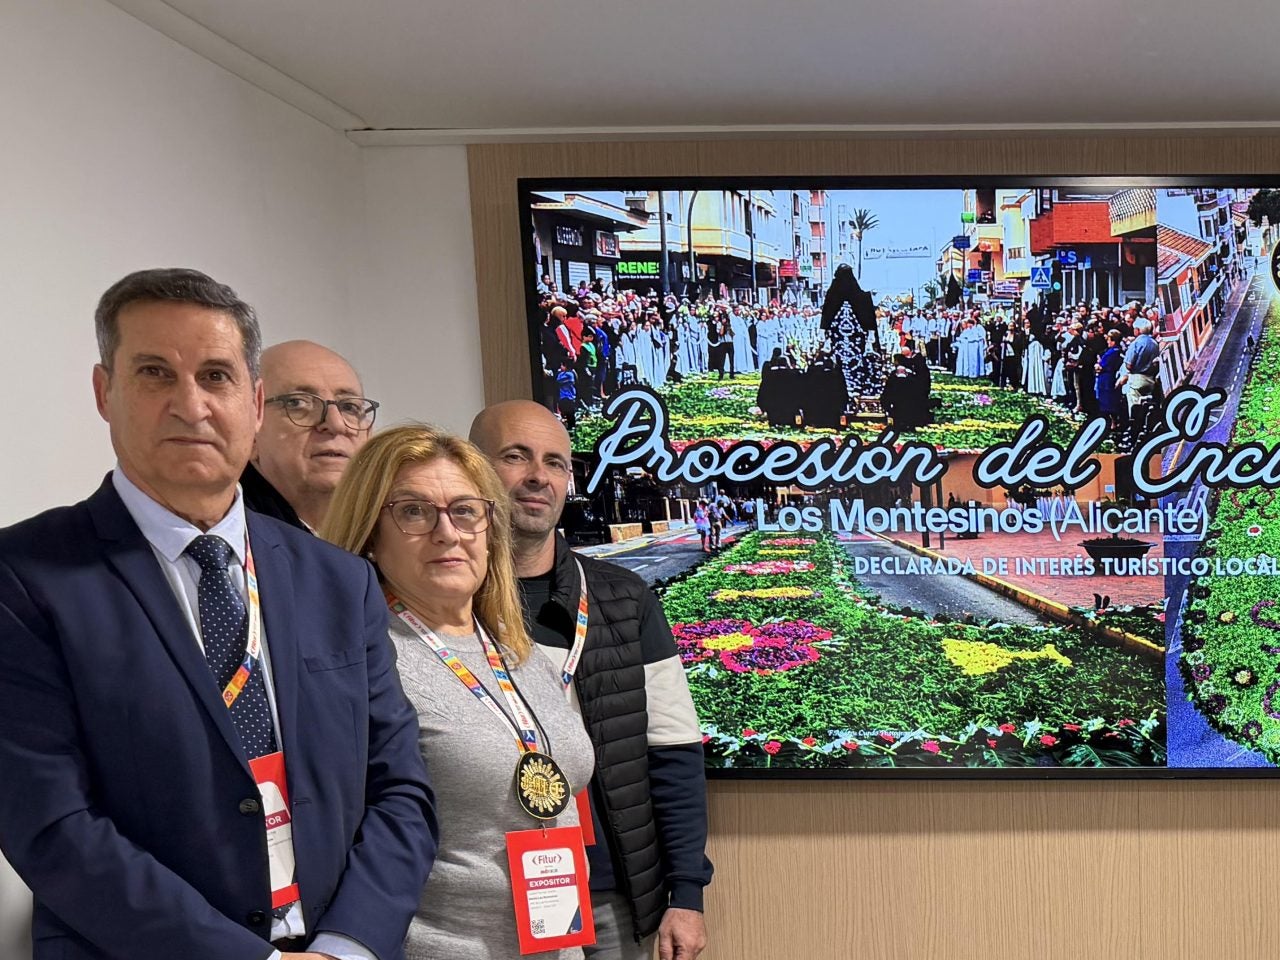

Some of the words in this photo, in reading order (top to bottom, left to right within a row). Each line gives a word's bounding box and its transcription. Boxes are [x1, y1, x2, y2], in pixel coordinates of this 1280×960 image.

[587, 390, 943, 494] Procesión
[975, 418, 1106, 484] del
[757, 500, 823, 533] Los
[832, 500, 1042, 533] Montesinos
[1051, 500, 1209, 541] (Alicante)
[855, 556, 974, 575] DECLARADA
[984, 557, 1007, 575] DE
[1015, 554, 1095, 576] INTERÉS
[1102, 554, 1209, 576] TURÍSTICO
[529, 877, 571, 888] EXPOSITOR
